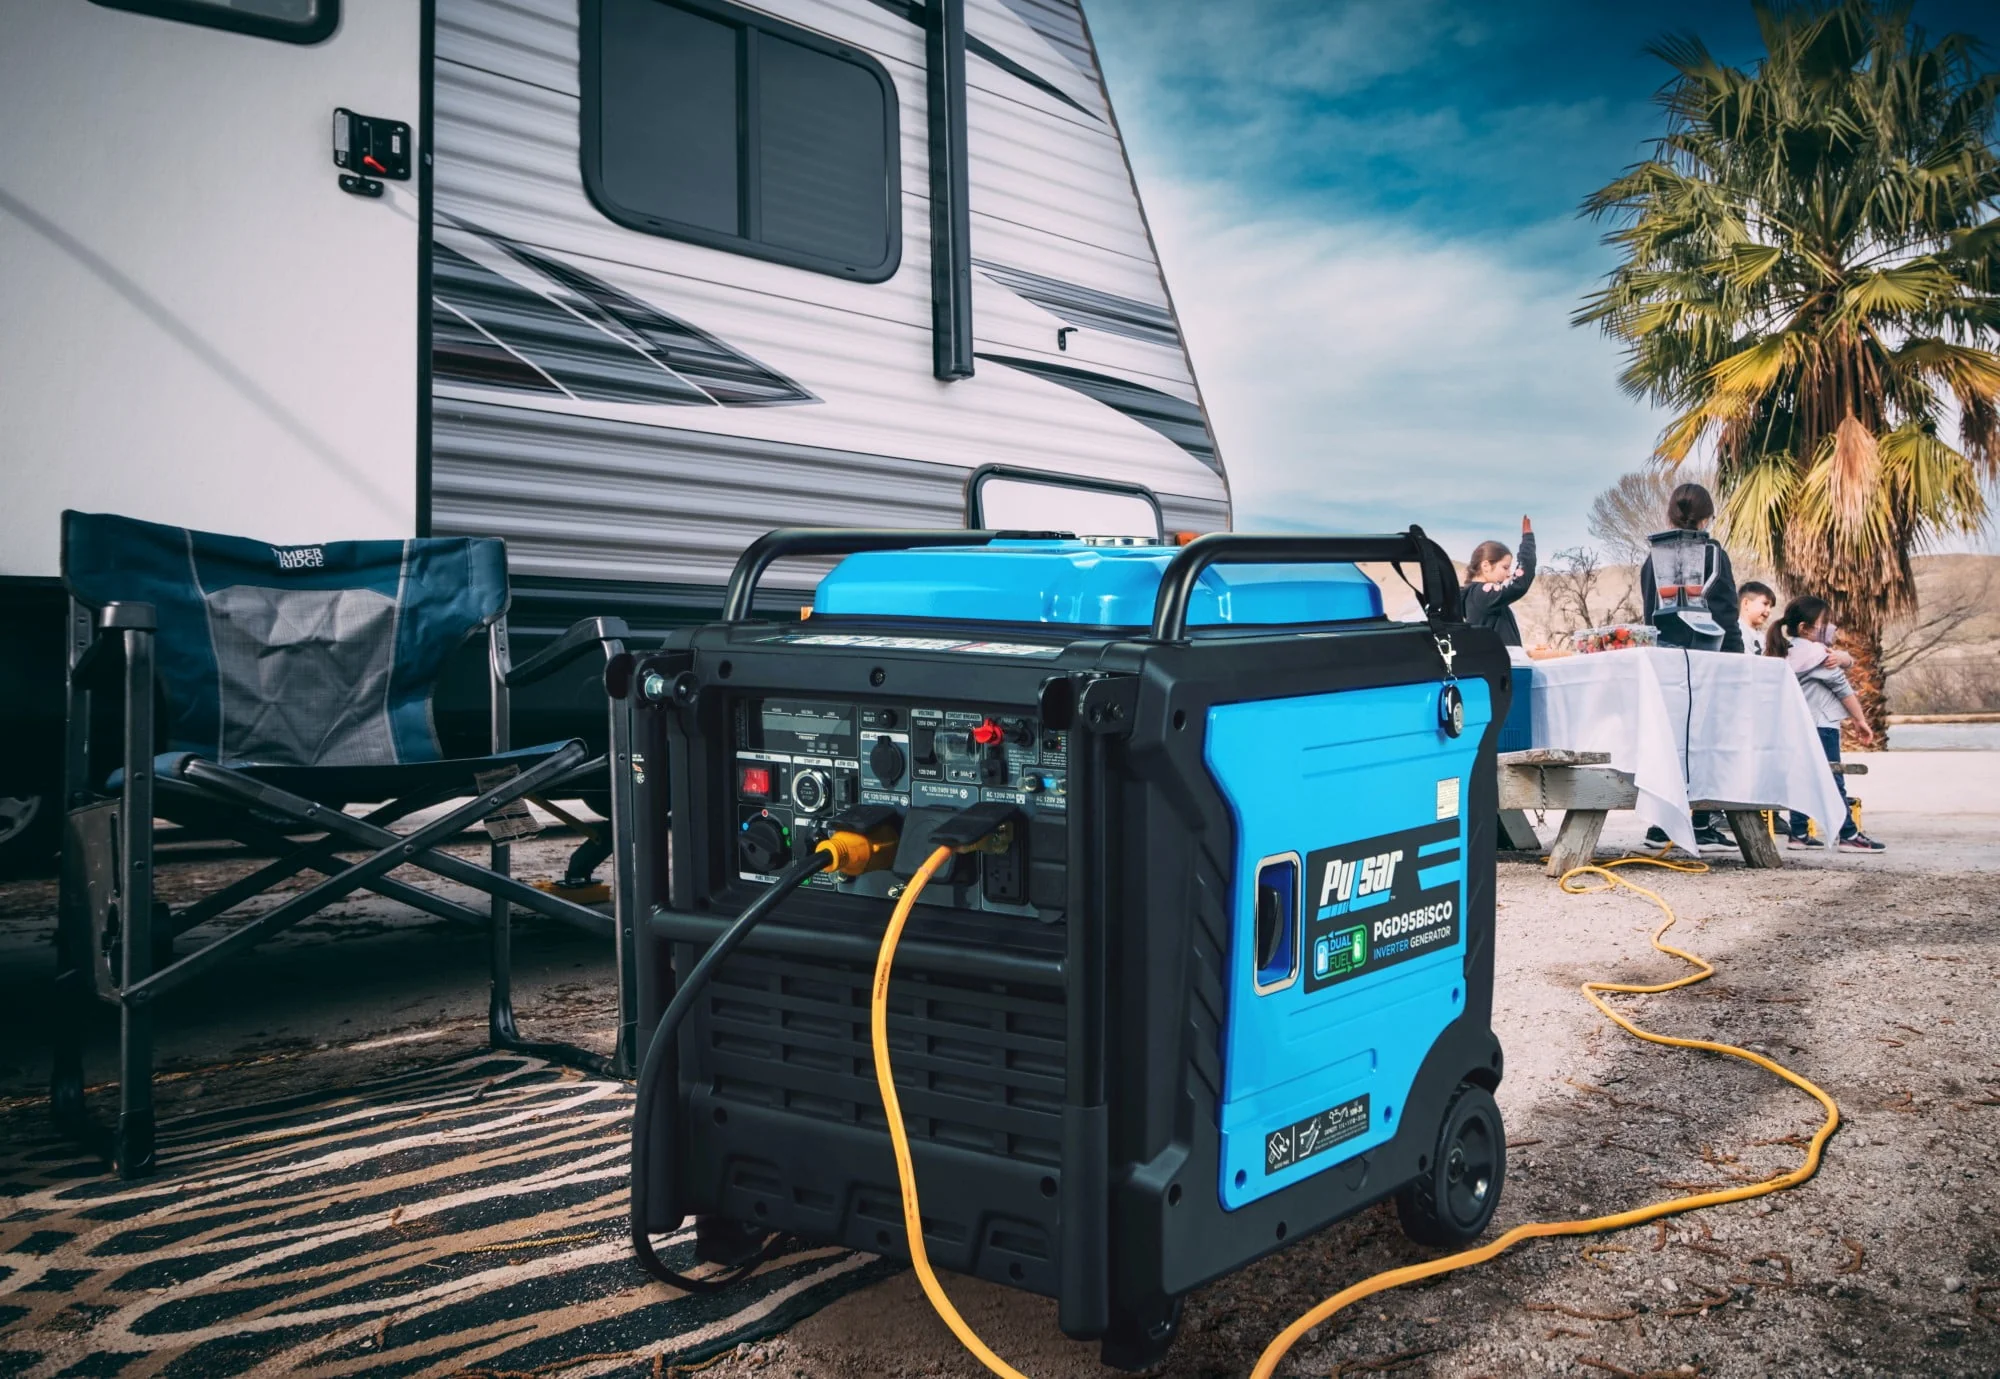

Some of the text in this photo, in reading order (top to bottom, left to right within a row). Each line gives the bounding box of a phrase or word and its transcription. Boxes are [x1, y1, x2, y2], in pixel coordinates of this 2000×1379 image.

[280, 557, 324, 568] RIDGE
[1373, 900, 1453, 942] PGD95BiSCO
[1330, 935, 1352, 951] DUAL
[1373, 926, 1451, 960] INVERTER GENERATOR
[1329, 953, 1351, 970] FUEL
